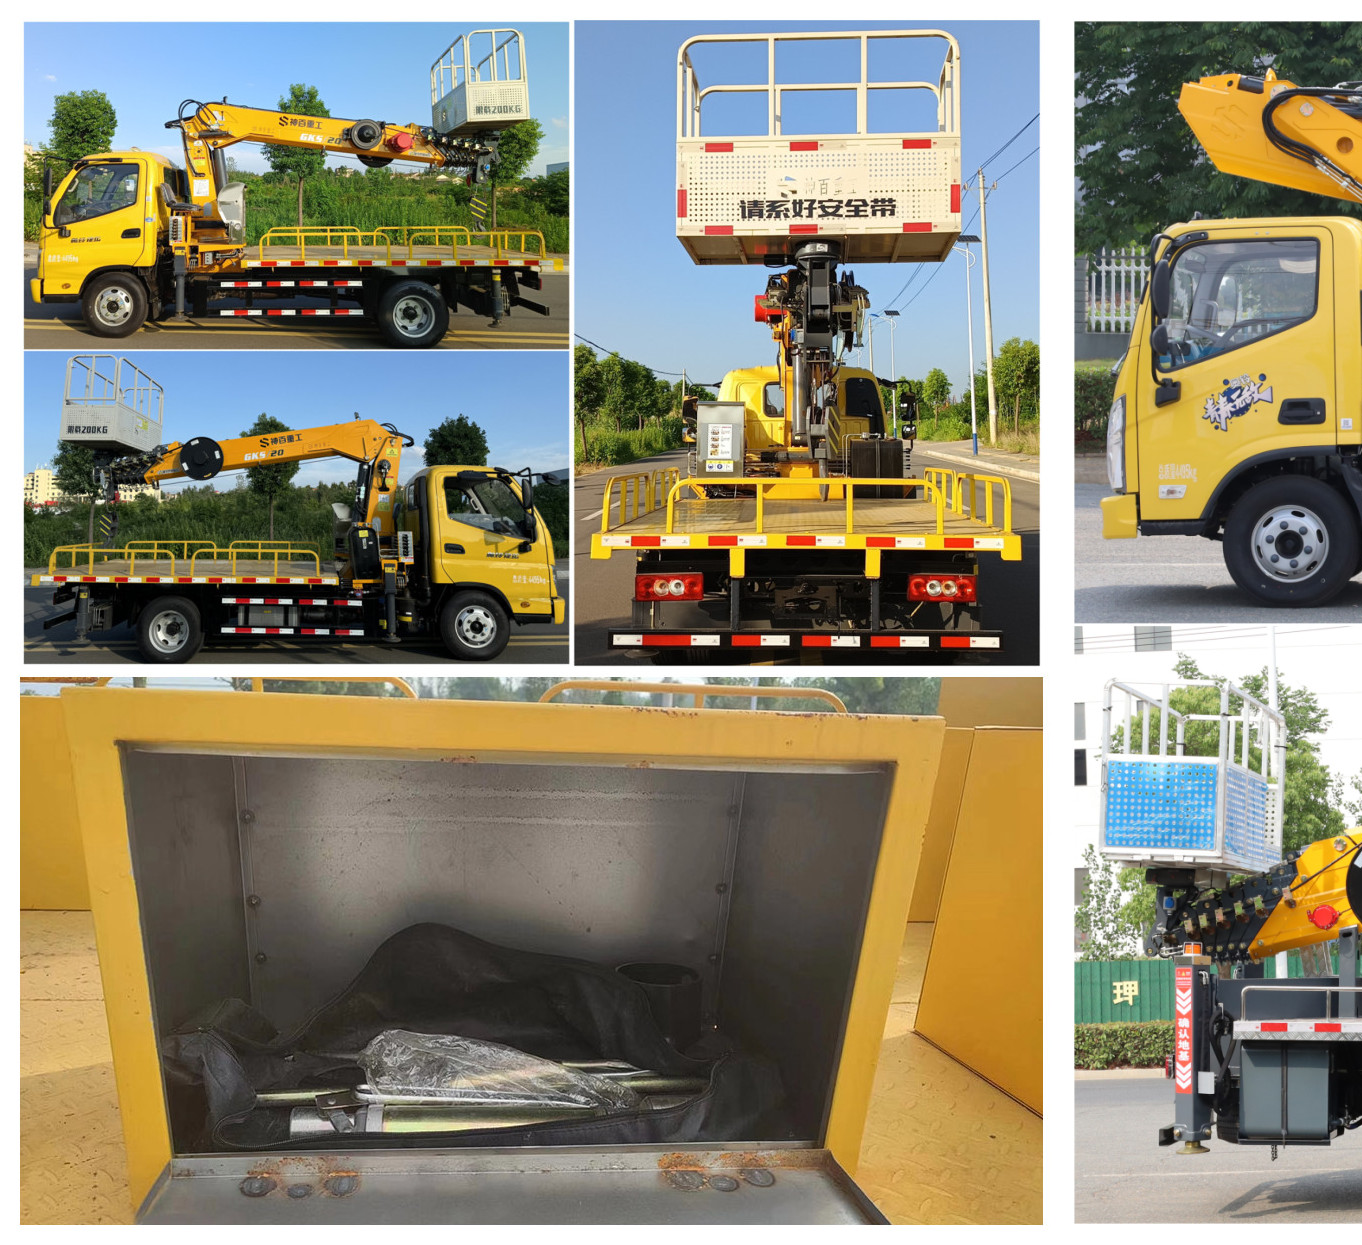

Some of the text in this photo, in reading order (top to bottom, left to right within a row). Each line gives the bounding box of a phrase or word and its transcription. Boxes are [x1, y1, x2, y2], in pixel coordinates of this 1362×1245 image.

[739, 198, 897, 219] 请系好安全带
[1112, 980, 1139, 1006] 理
[1177, 1017, 1190, 1061] 确认地基
